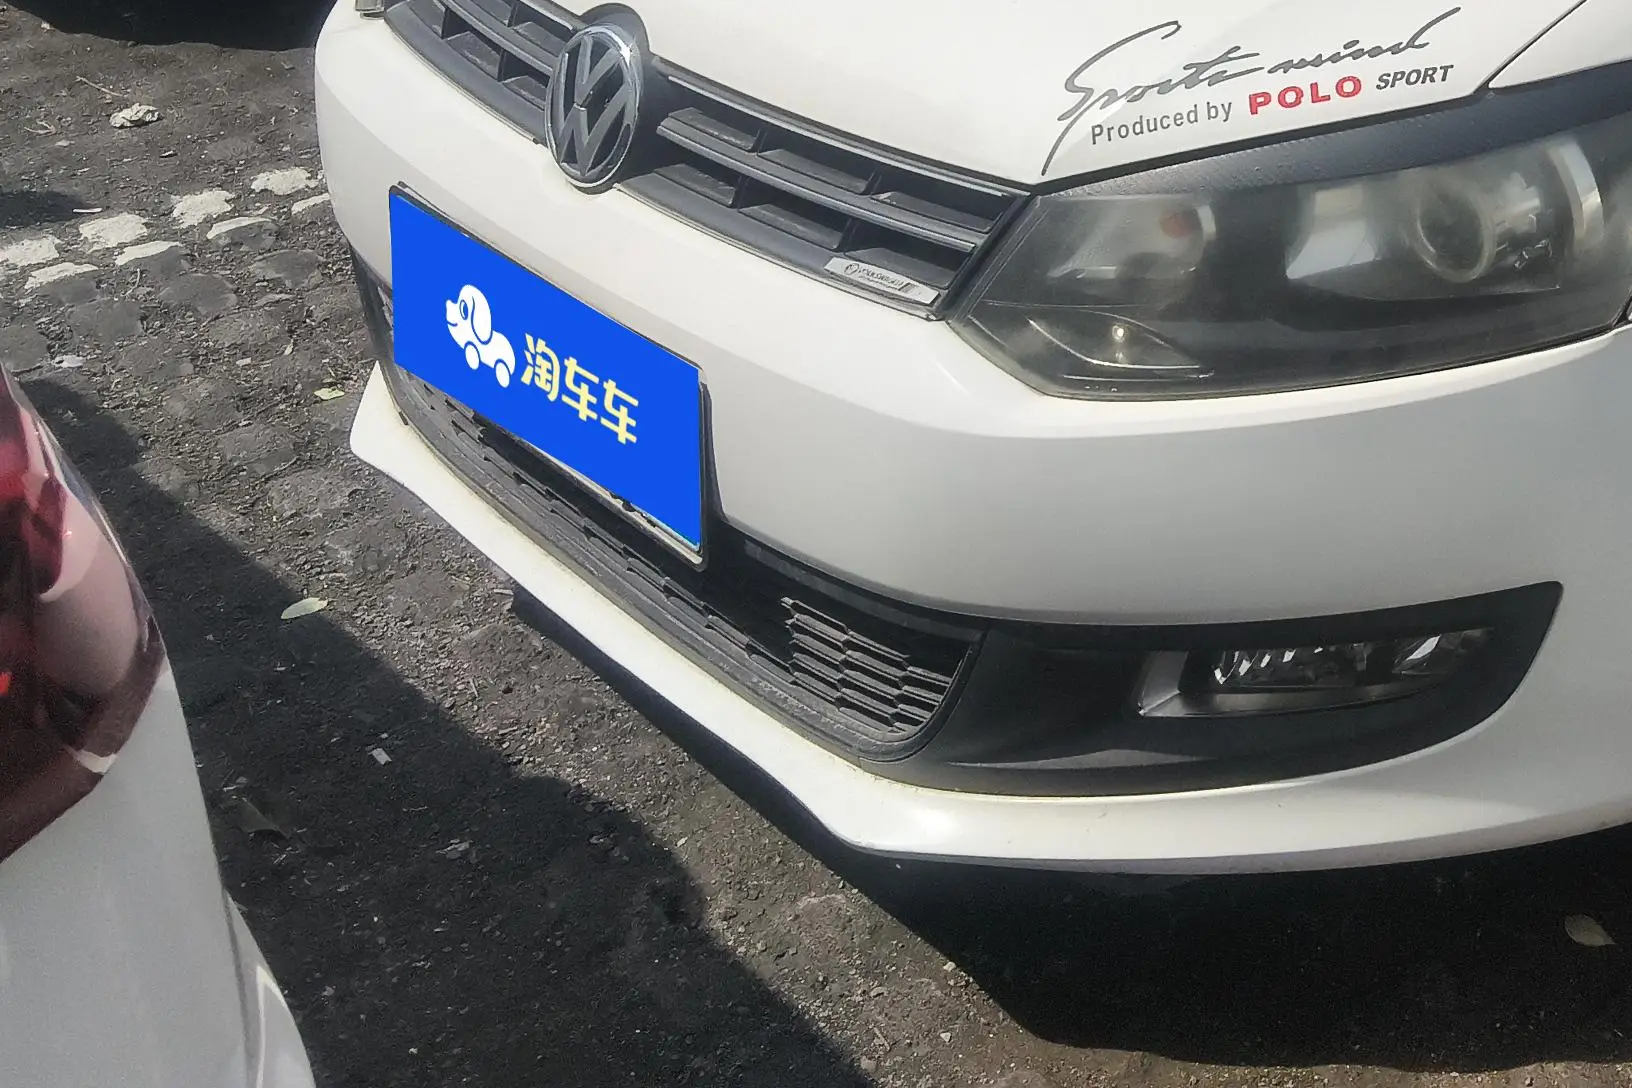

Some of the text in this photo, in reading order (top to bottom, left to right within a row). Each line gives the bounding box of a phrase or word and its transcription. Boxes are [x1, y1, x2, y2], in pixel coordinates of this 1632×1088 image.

[1091, 64, 1456, 145] Produced by POLO SPORT
